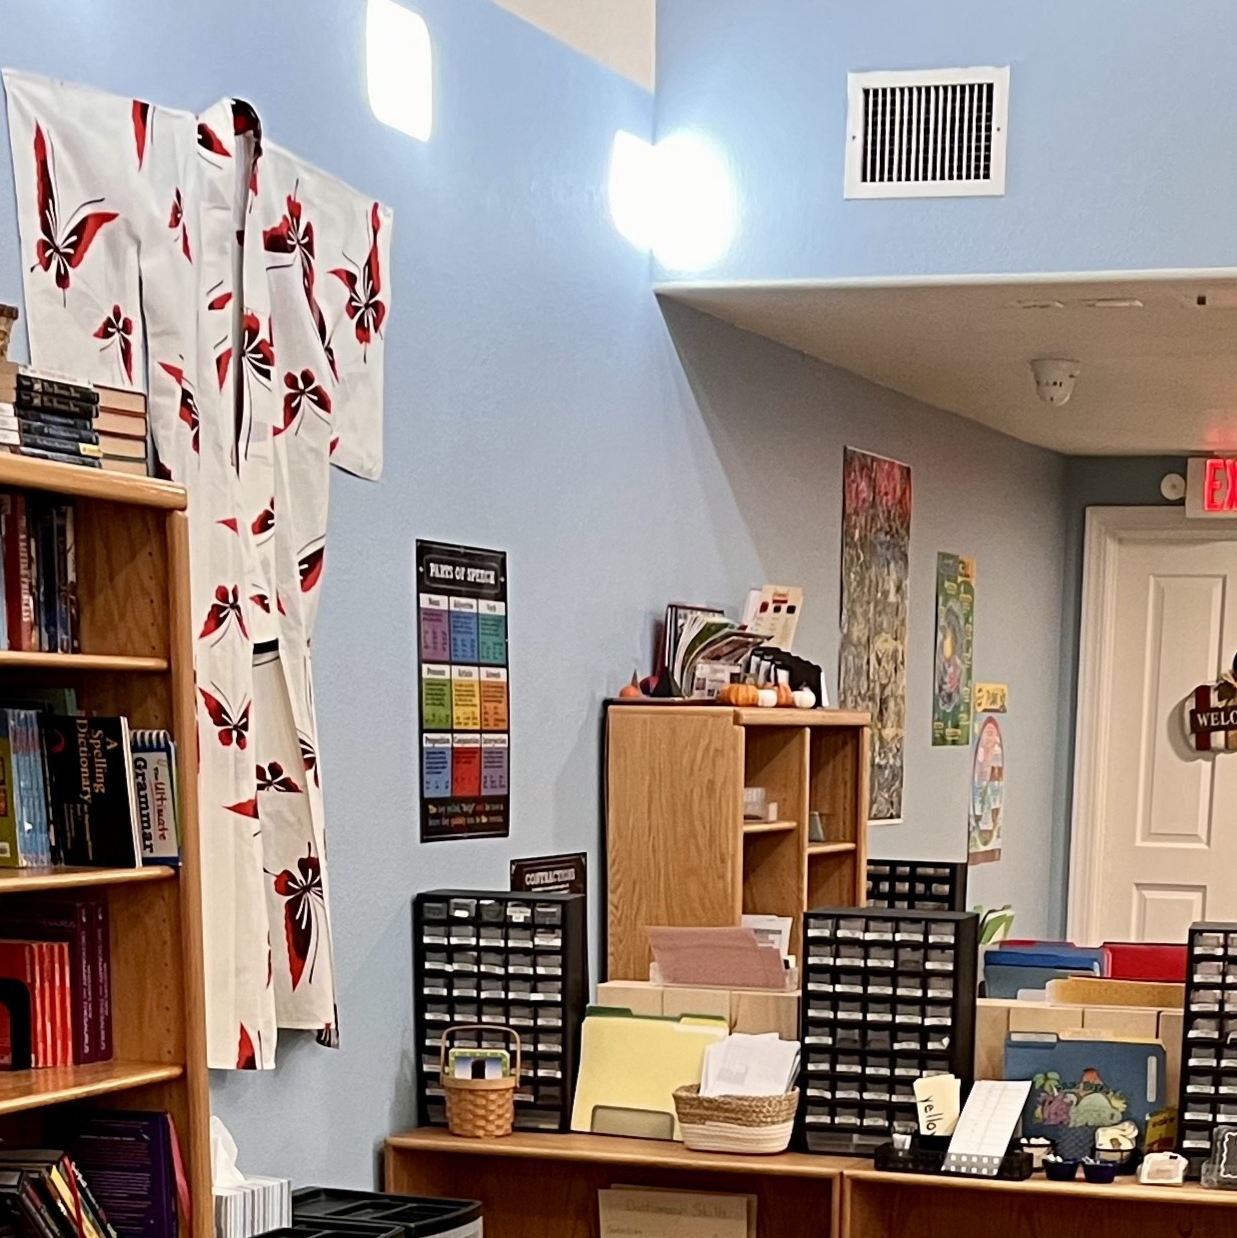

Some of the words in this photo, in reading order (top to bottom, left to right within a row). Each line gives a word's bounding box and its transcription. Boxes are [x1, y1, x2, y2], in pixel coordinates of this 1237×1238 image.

[429, 560, 454, 579] PARTS
[454, 564, 466, 581] OF
[466, 566, 496, 585] SPEECH
[75, 717, 92, 806] Dictionary
[91, 729, 106, 795] Spelling
[105, 737, 118, 750] A
[134, 755, 155, 854] Grammar
[154, 780, 167, 842] Ultimate
[917, 1095, 945, 1136] yello
